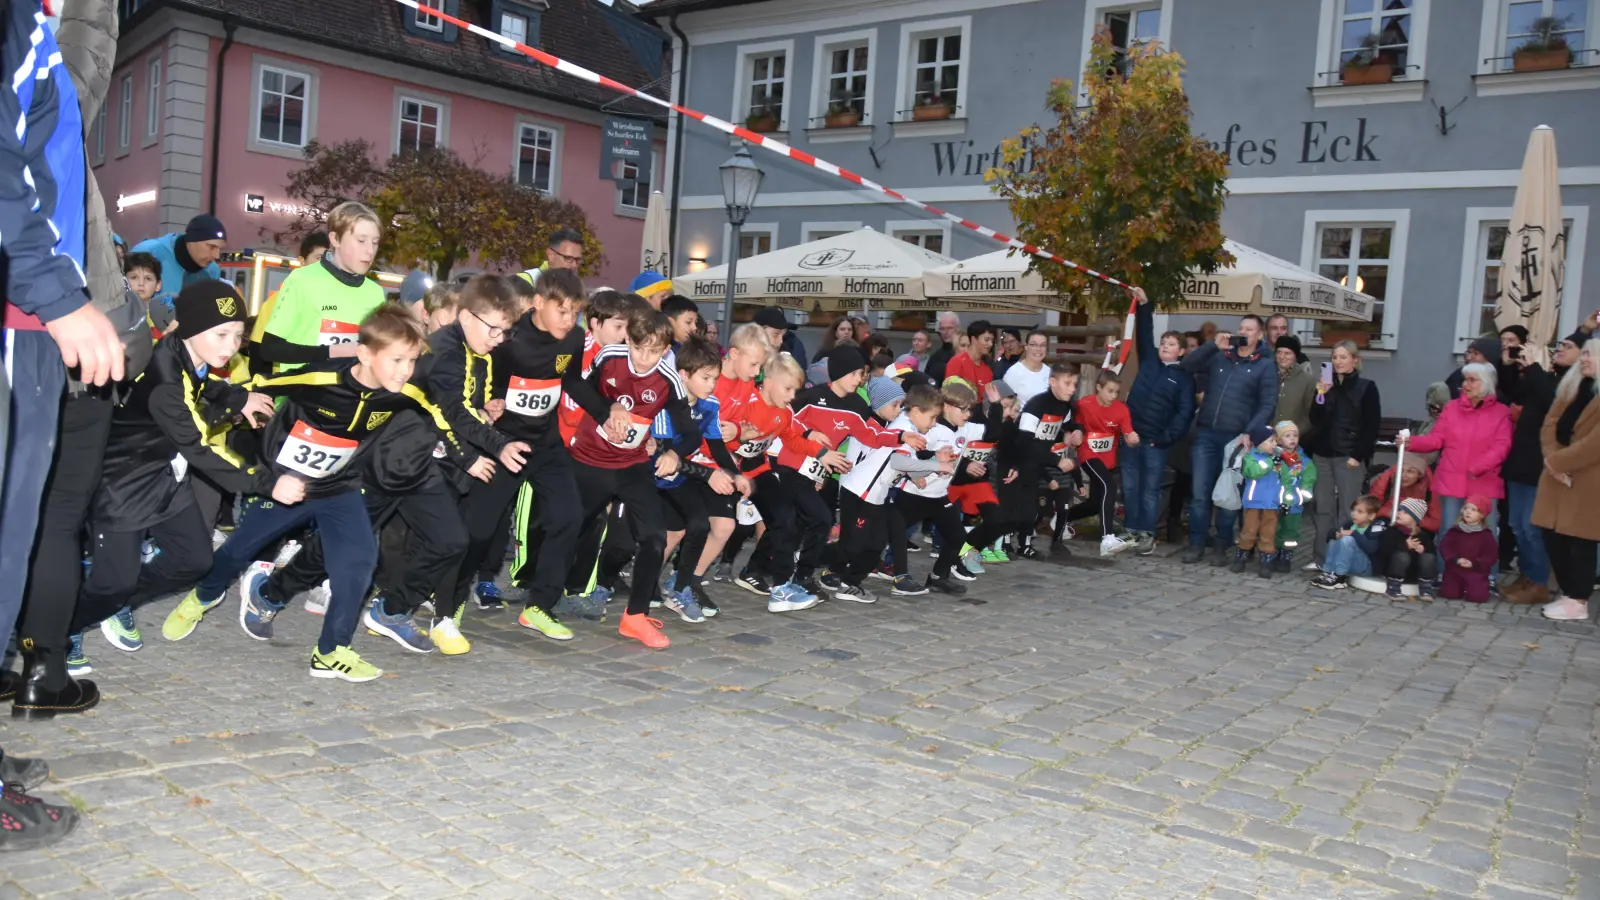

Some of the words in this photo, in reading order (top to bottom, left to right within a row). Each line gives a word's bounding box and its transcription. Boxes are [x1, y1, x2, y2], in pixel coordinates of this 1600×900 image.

[1297, 117, 1381, 163] Eck
[694, 280, 747, 295] Hofmnn
[767, 278, 823, 293] Hofmann
[844, 278, 904, 294] Hofmann
[951, 274, 1016, 290] Hofmann
[516, 392, 551, 410] 369
[1042, 423, 1058, 437] 311
[1091, 440, 1109, 449] 320
[293, 444, 341, 471] 327
[260, 501, 274, 509] JD
